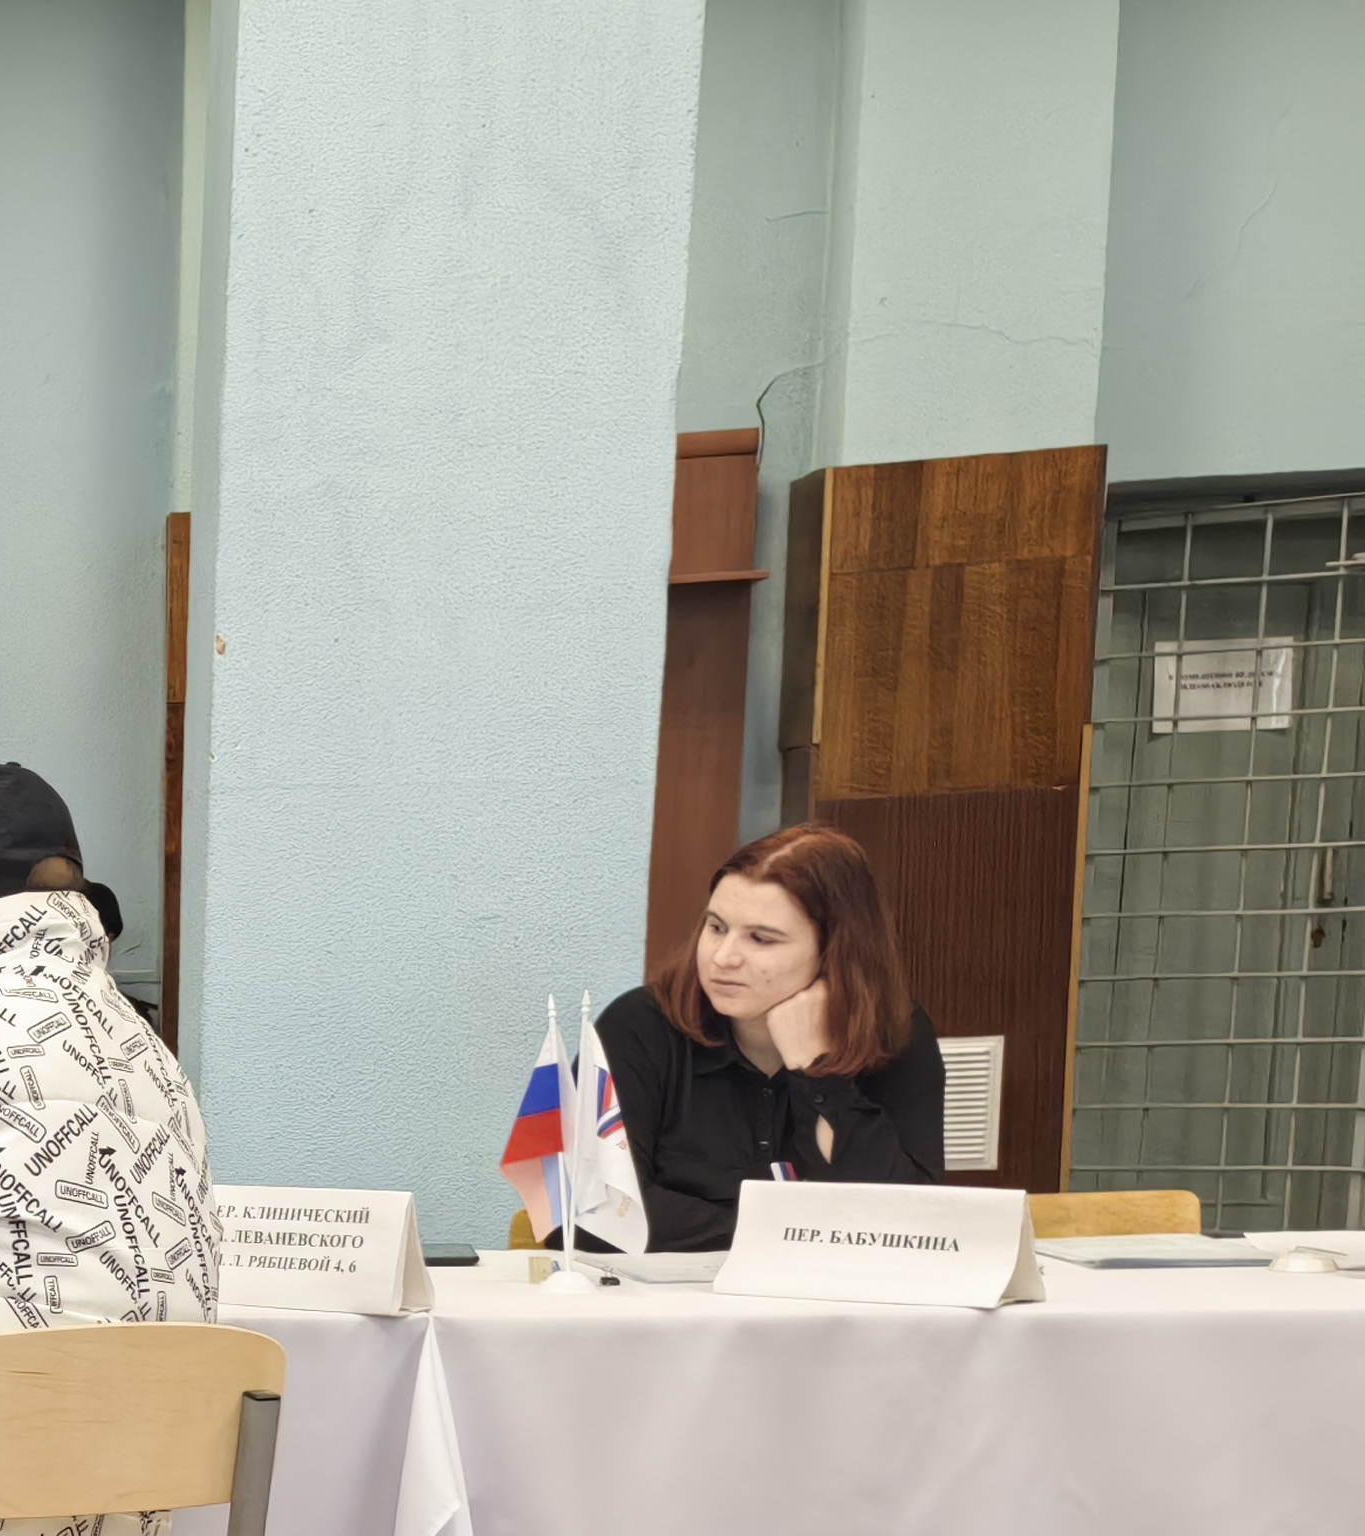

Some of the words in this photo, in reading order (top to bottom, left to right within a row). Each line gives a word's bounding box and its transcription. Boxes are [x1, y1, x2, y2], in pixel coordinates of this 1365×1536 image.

[33, 1017, 69, 1039] UNOFFCALL
[49, 974, 114, 1039] NOFFCALL
[62, 992, 113, 1084] UNOFFCALL
[24, 1104, 98, 1177] UNOFFCALL
[85, 1132, 99, 1185] UNOFFCALL
[130, 1124, 171, 1185] UNOFFCALL
[60, 1186, 105, 1204] UNOFFCALL
[98, 1151, 161, 1248] UNOFFCALL
[216, 1205, 238, 1218] ЕР.
[243, 1206, 370, 1224] КЛИНИЧЕСКИЙ
[41, 1255, 75, 1263] UNOFFCALL
[114, 1195, 151, 1298] UNOFFCALL
[188, 1213, 213, 1313] UNOFFCALL
[231, 1230, 364, 1249] ЛЕВАНЕВСКОГО
[248, 1255, 331, 1272] РЯБЦЕВОЙ
[333, 1260, 344, 1274] 4,
[349, 1260, 357, 1273] 6
[783, 1227, 823, 1243] ПЕР.
[829, 1230, 960, 1252] БАБУШКИНА
